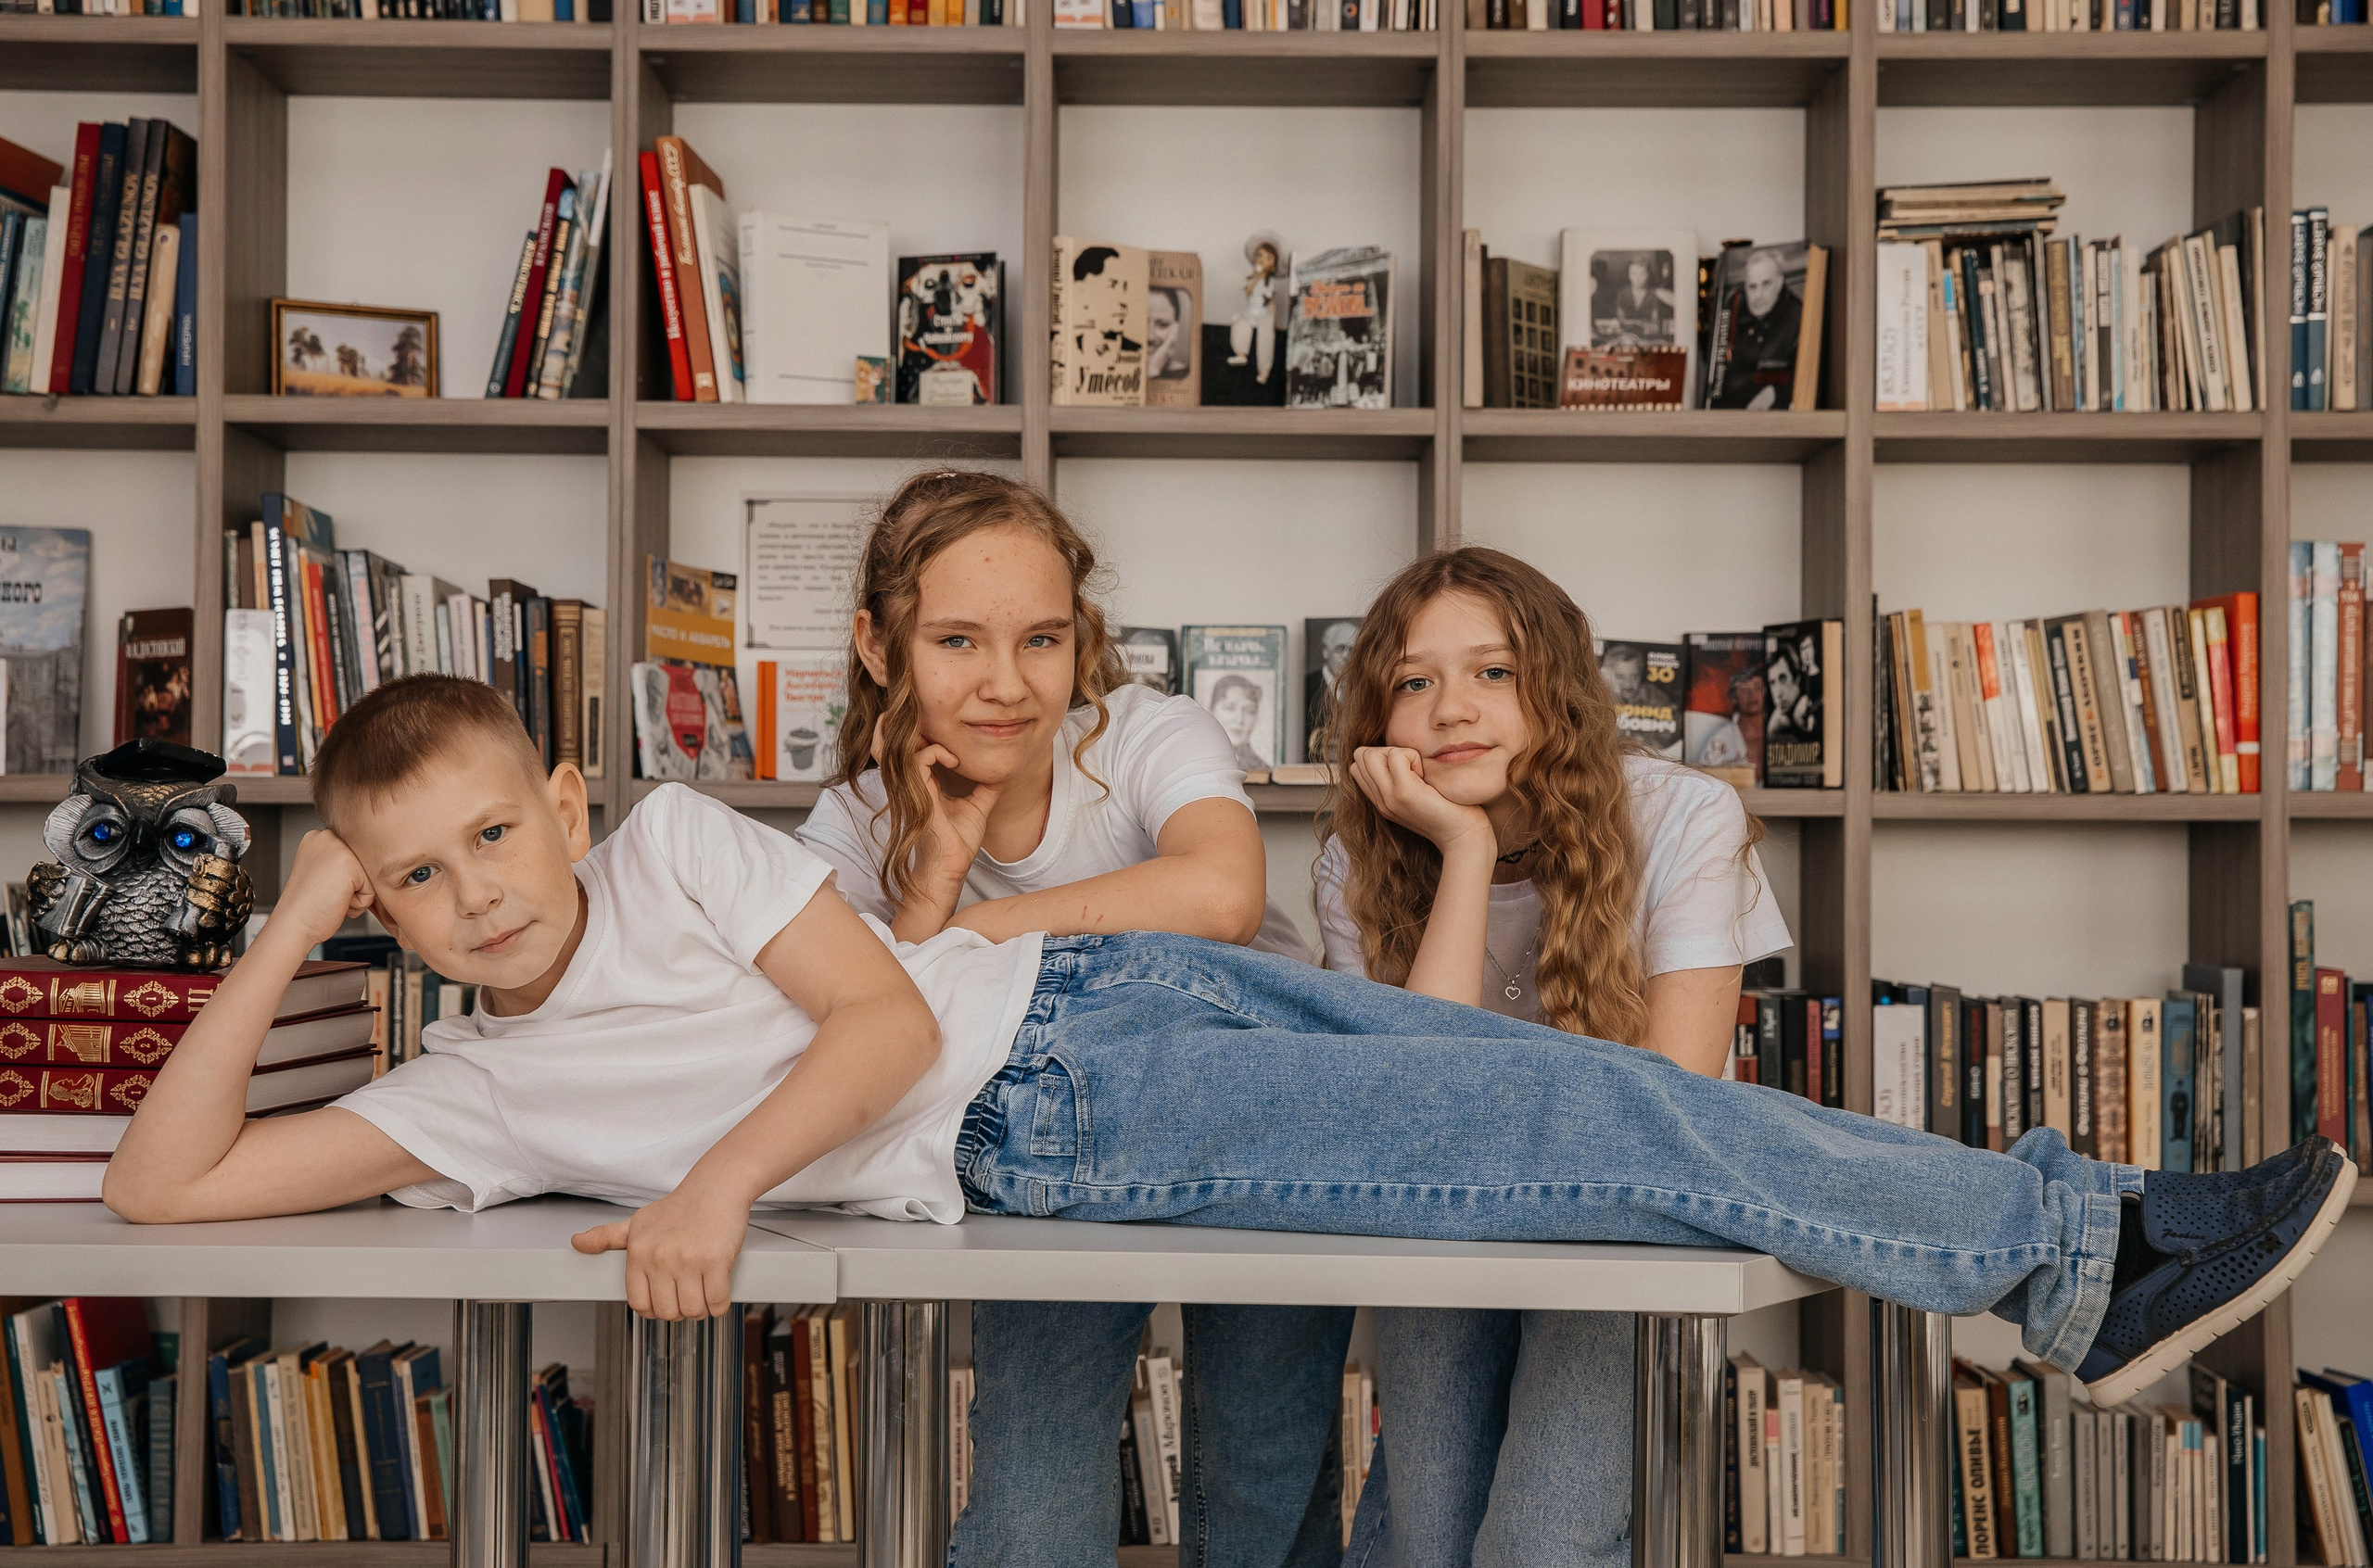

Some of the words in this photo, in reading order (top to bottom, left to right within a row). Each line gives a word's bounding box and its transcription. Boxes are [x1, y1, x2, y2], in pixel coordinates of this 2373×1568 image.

[111, 170, 138, 259] GLAZUNOV
[132, 170, 158, 259] GLAZUNOV
[108, 263, 127, 301] ILYA
[128, 263, 147, 301] ILYA
[1075, 365, 1142, 394] Утёсов
[1567, 377, 1671, 391] КИНОТЕАТРЫ
[1646, 666, 1676, 683] 30
[1967, 1429, 1985, 1489] ОЛИВЬЕ
[1971, 1493, 1989, 1555] ЛОРЕНС
